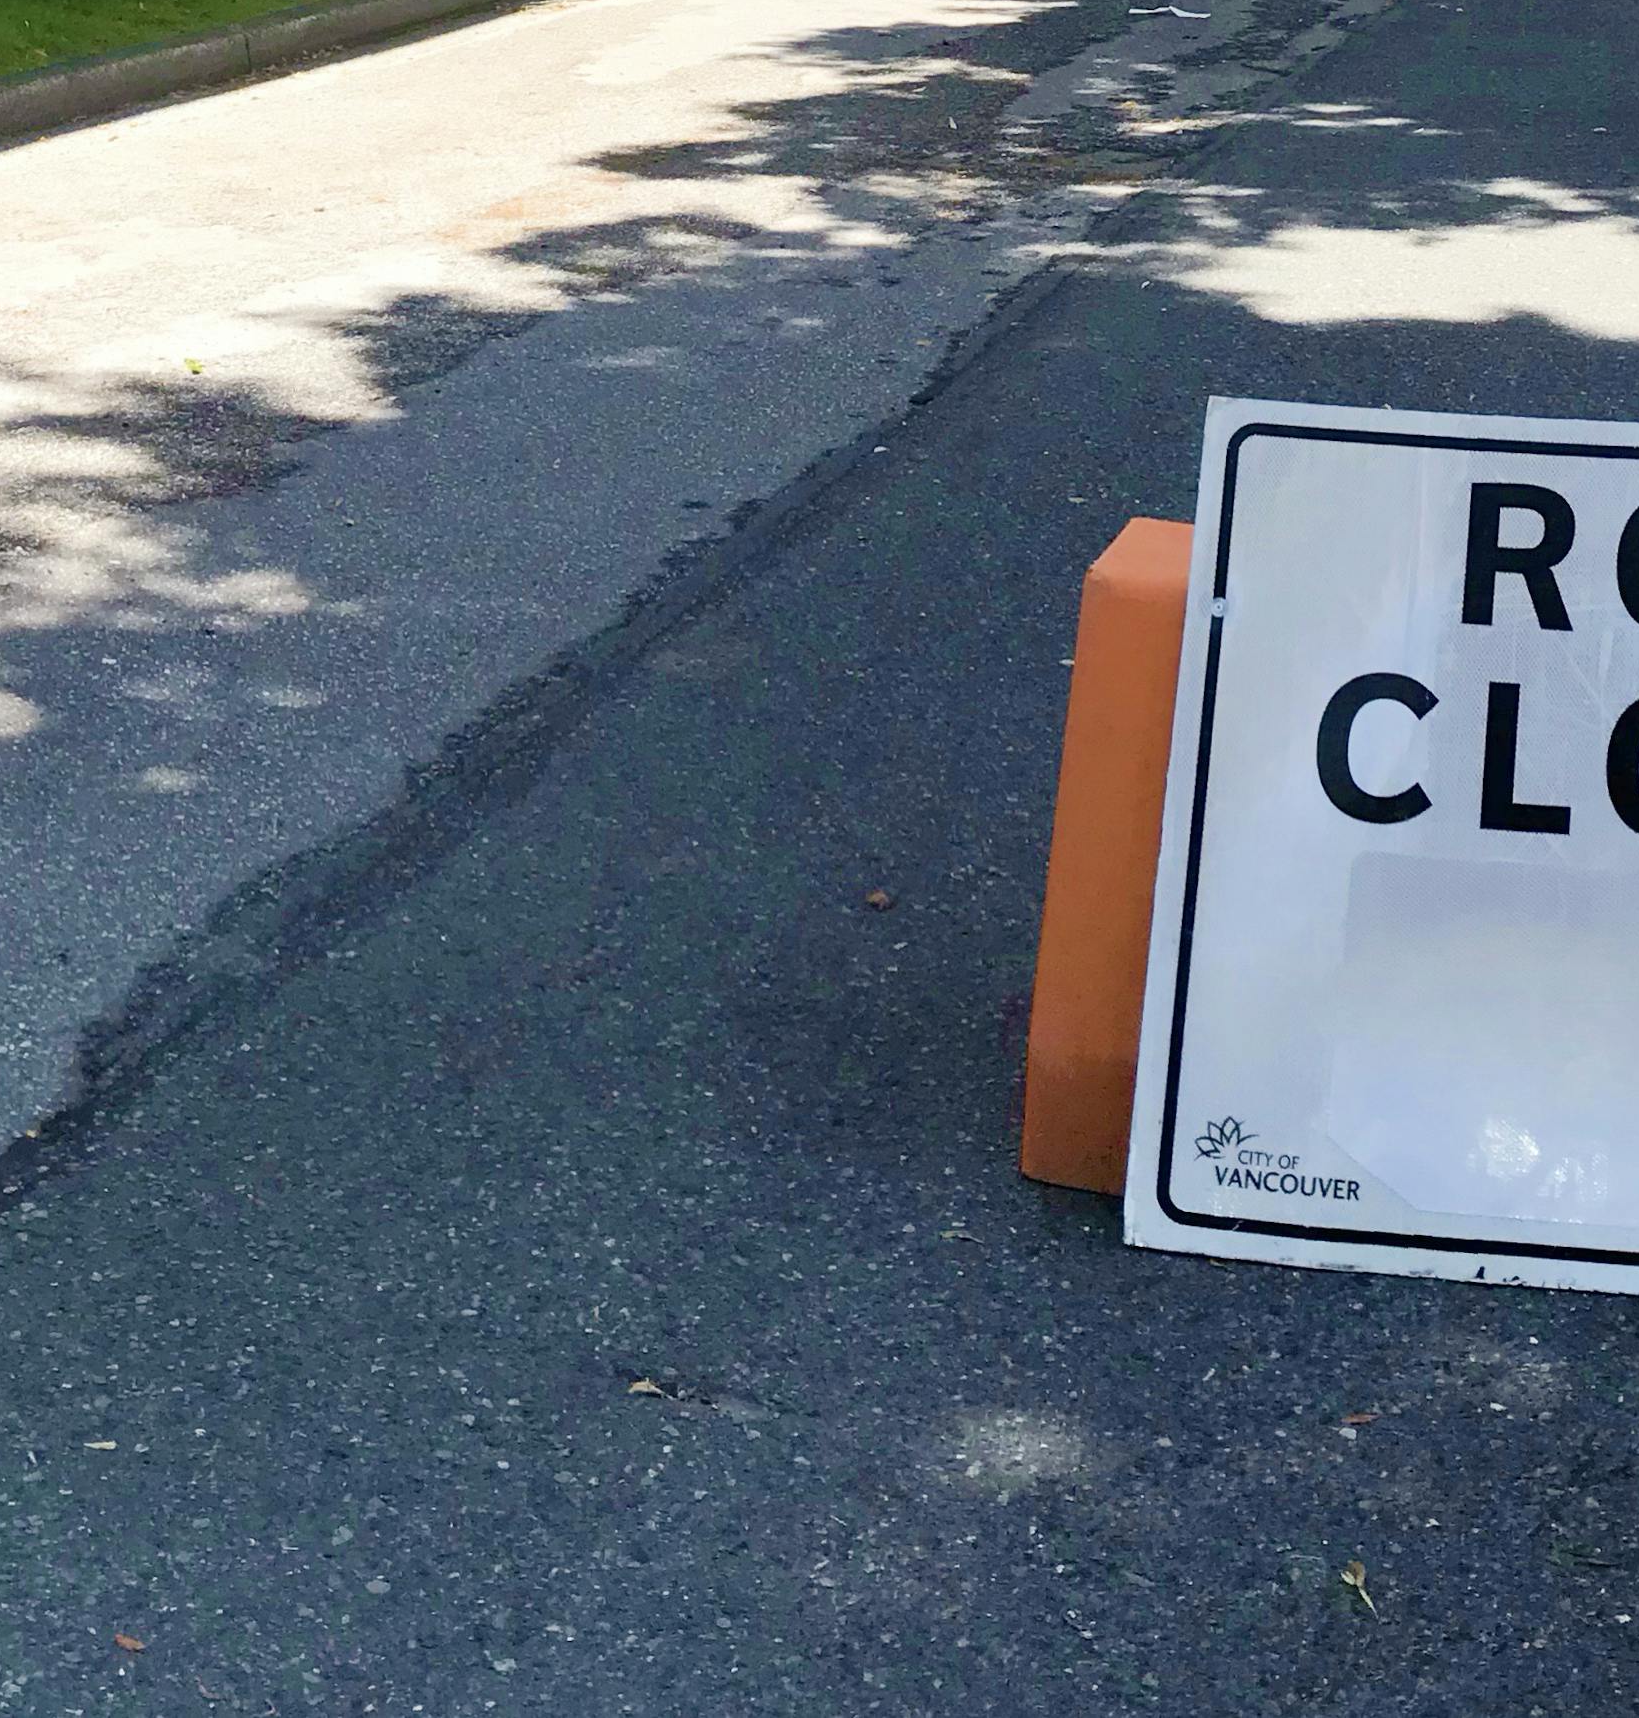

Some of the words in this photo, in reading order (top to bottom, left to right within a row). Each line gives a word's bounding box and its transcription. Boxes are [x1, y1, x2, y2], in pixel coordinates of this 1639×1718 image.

[1238, 1149, 1273, 1167] CITY
[1278, 1154, 1300, 1170] OF
[1214, 1165, 1360, 1201] VANCOUVER
